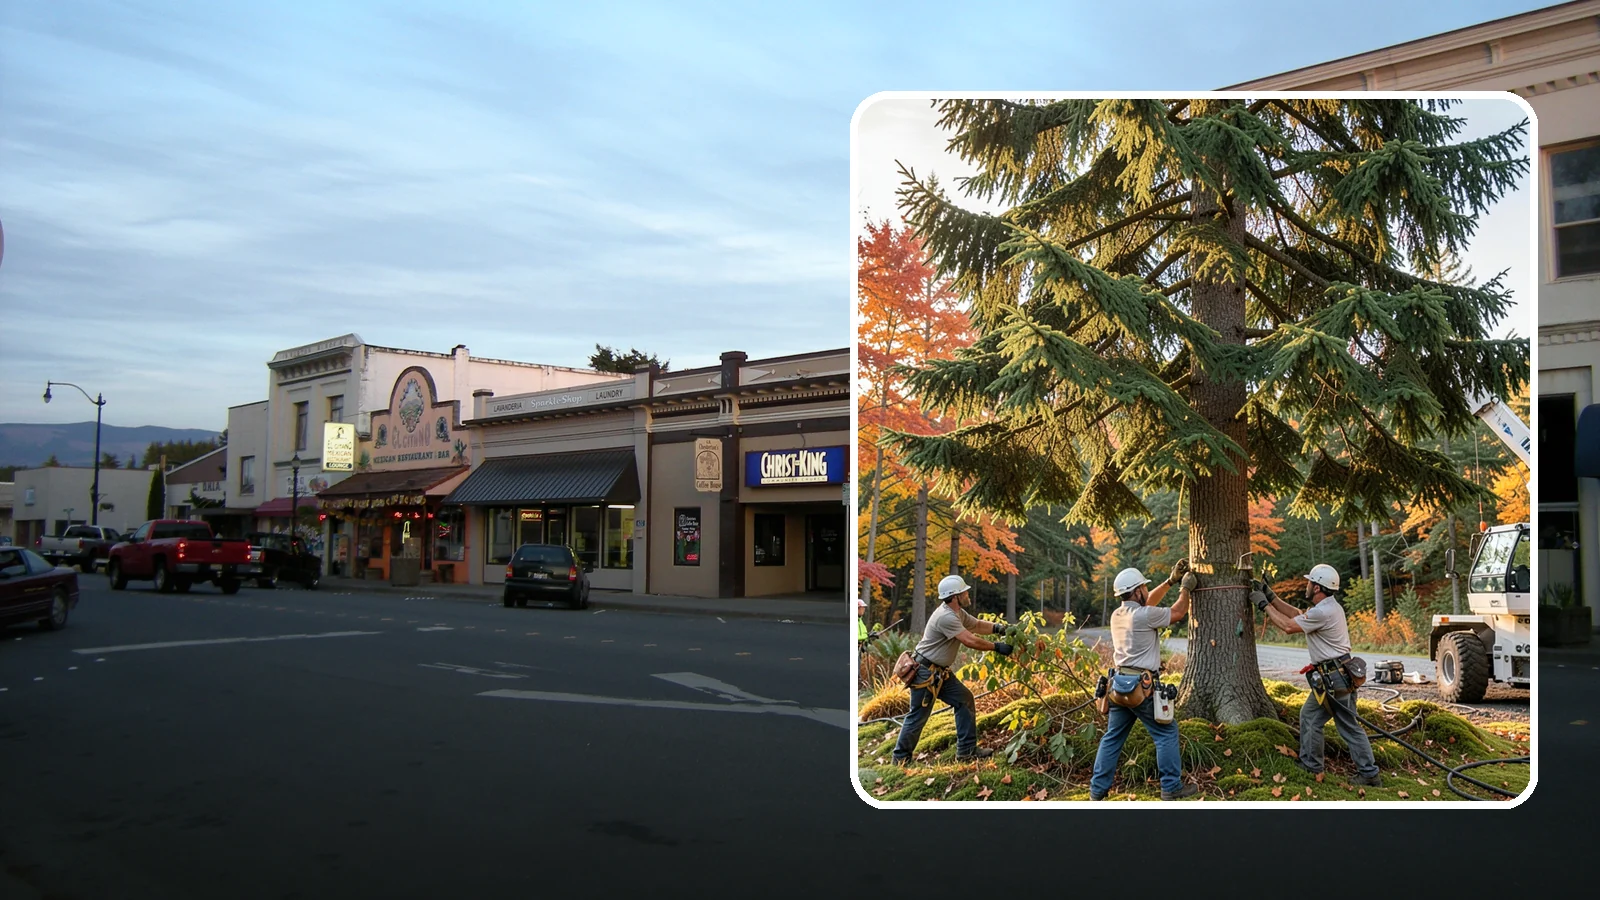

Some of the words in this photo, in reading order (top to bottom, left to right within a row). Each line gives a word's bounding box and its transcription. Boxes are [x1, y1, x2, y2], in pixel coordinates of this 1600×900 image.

[561, 394, 582, 405] Shop
[595, 389, 623, 400] LAUNDRY
[493, 402, 522, 412] LAVANDERIA
[373, 455, 396, 463] MEXICAN
[397, 451, 434, 462] RESTAURANT
[437, 450, 450, 459] BAR
[761, 452, 797, 478] CHRIST
[798, 450, 827, 476] KING
